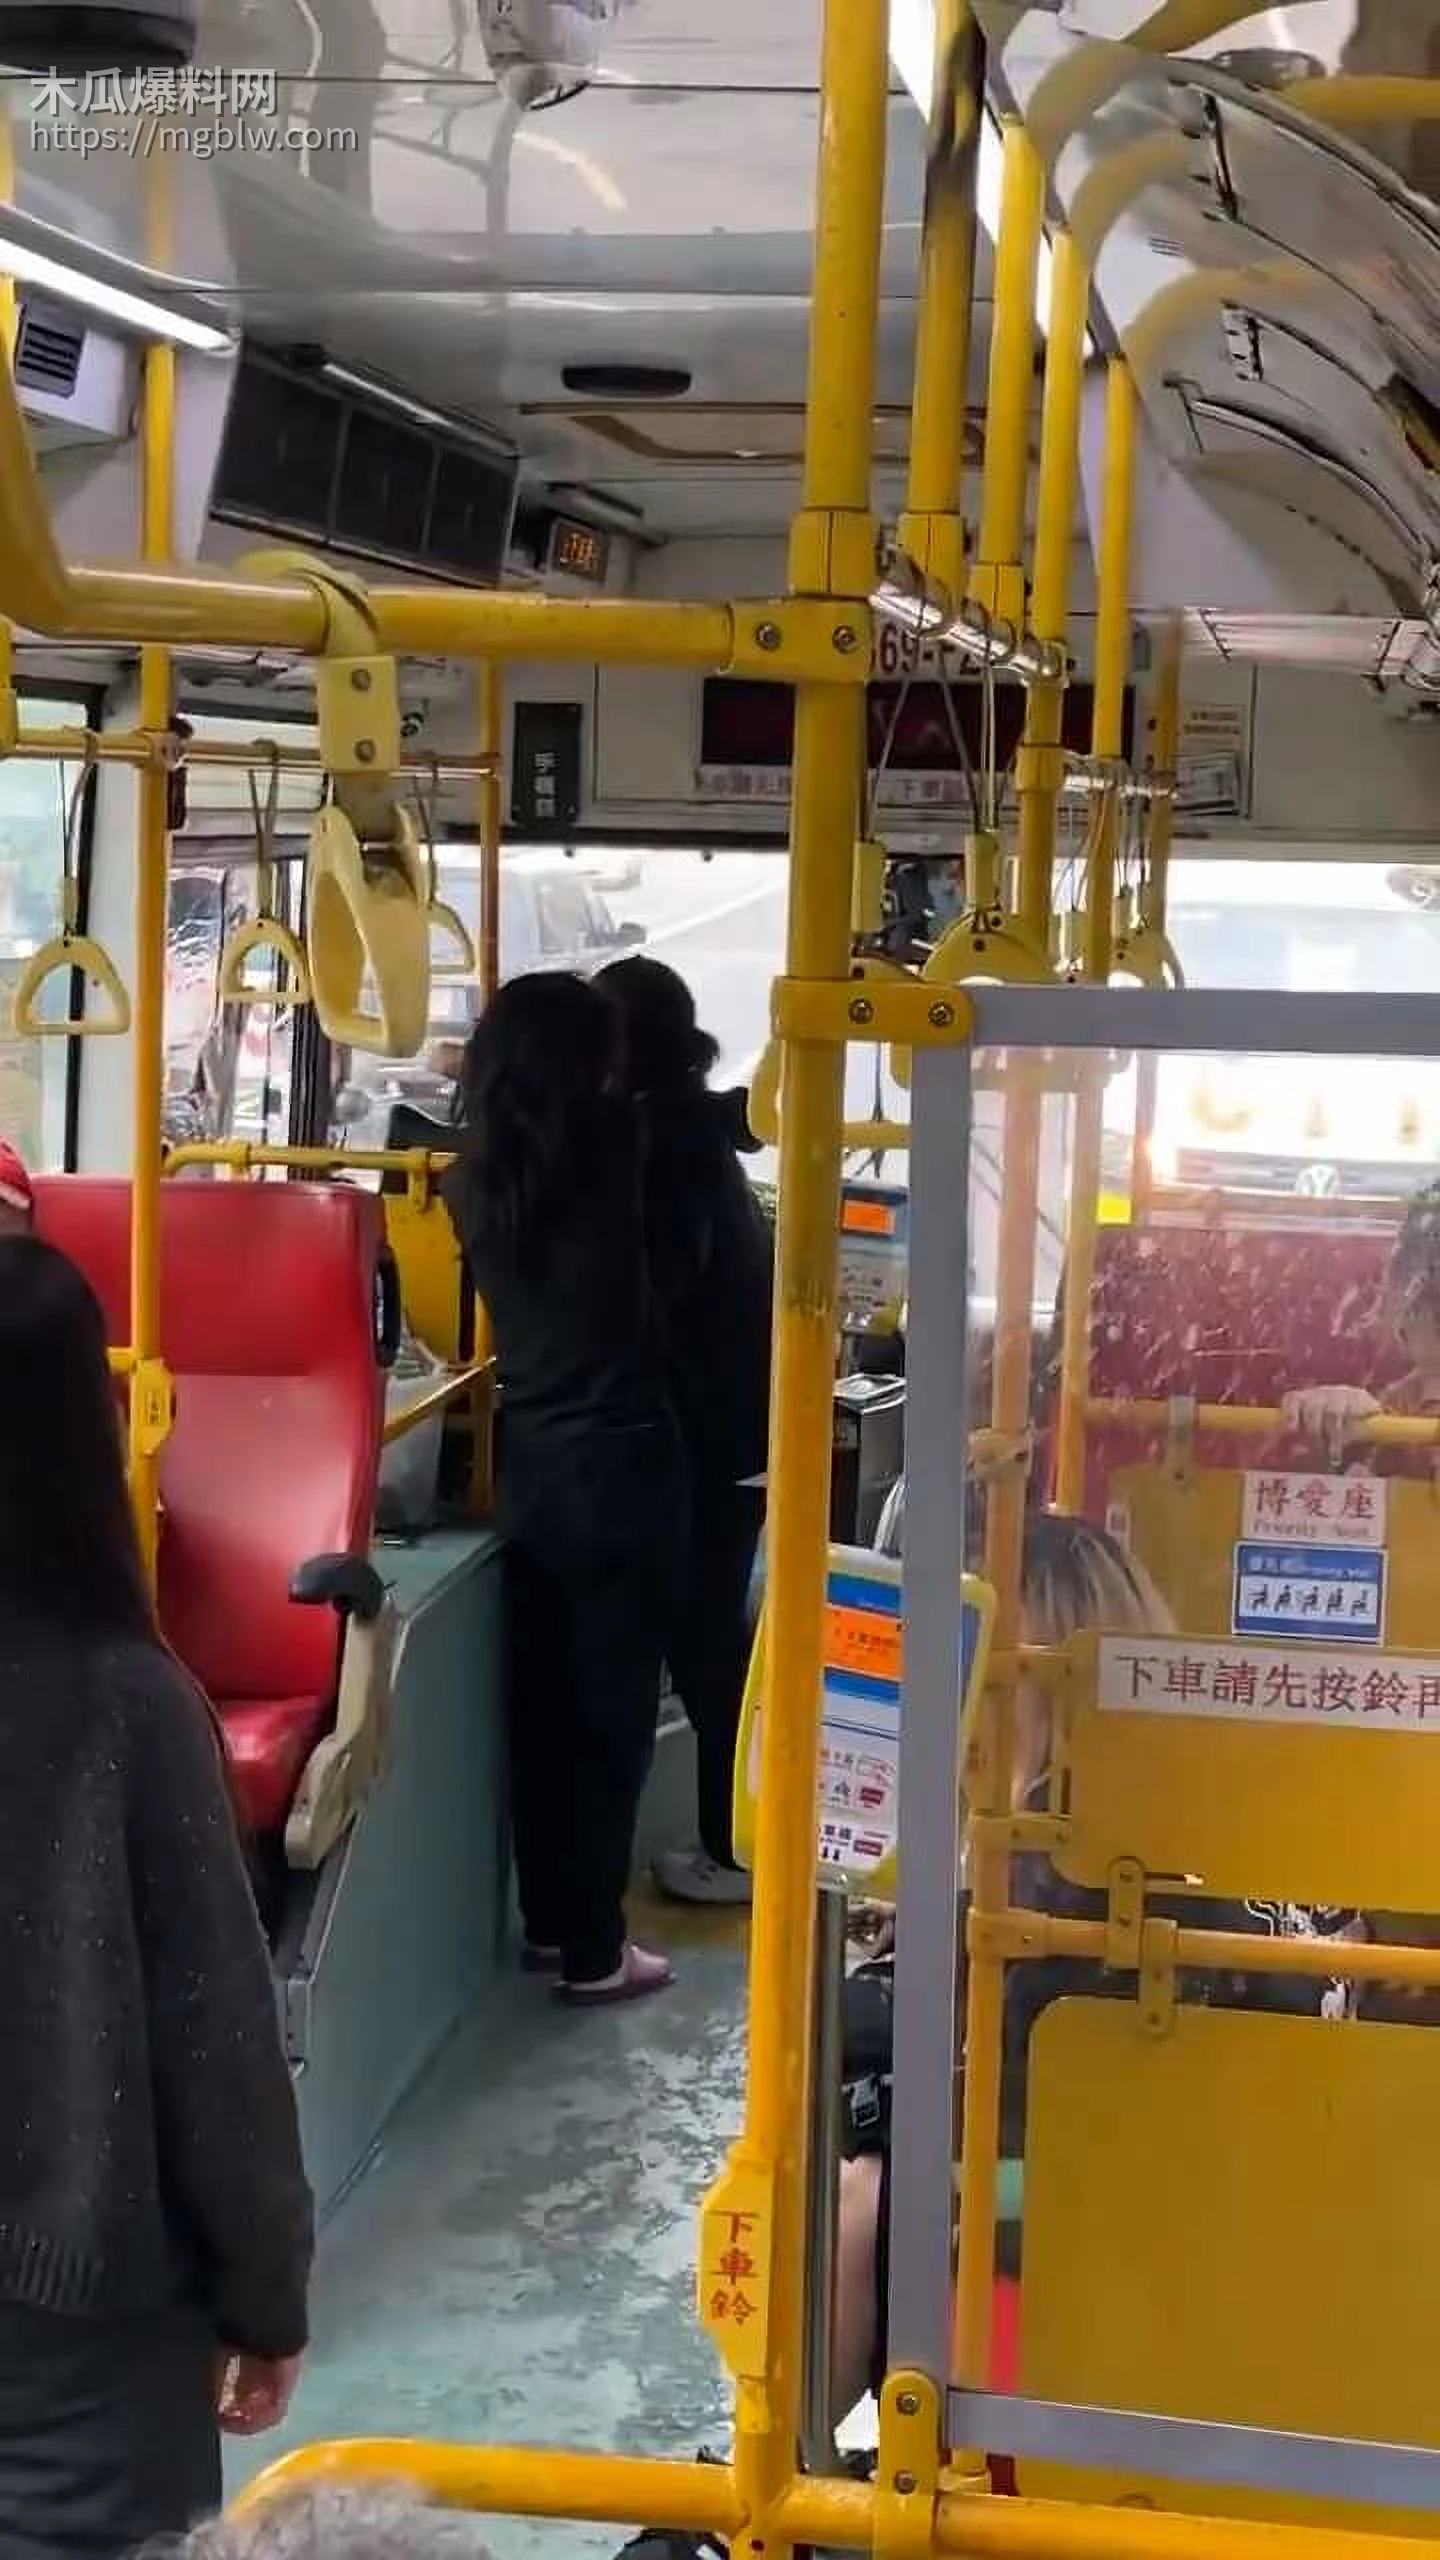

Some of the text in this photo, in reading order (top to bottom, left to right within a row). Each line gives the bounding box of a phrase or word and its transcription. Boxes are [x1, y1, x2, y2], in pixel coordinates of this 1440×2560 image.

[1252, 1478, 1377, 1519] 博愛座
[708, 2209, 761, 2326] 下車鈴
